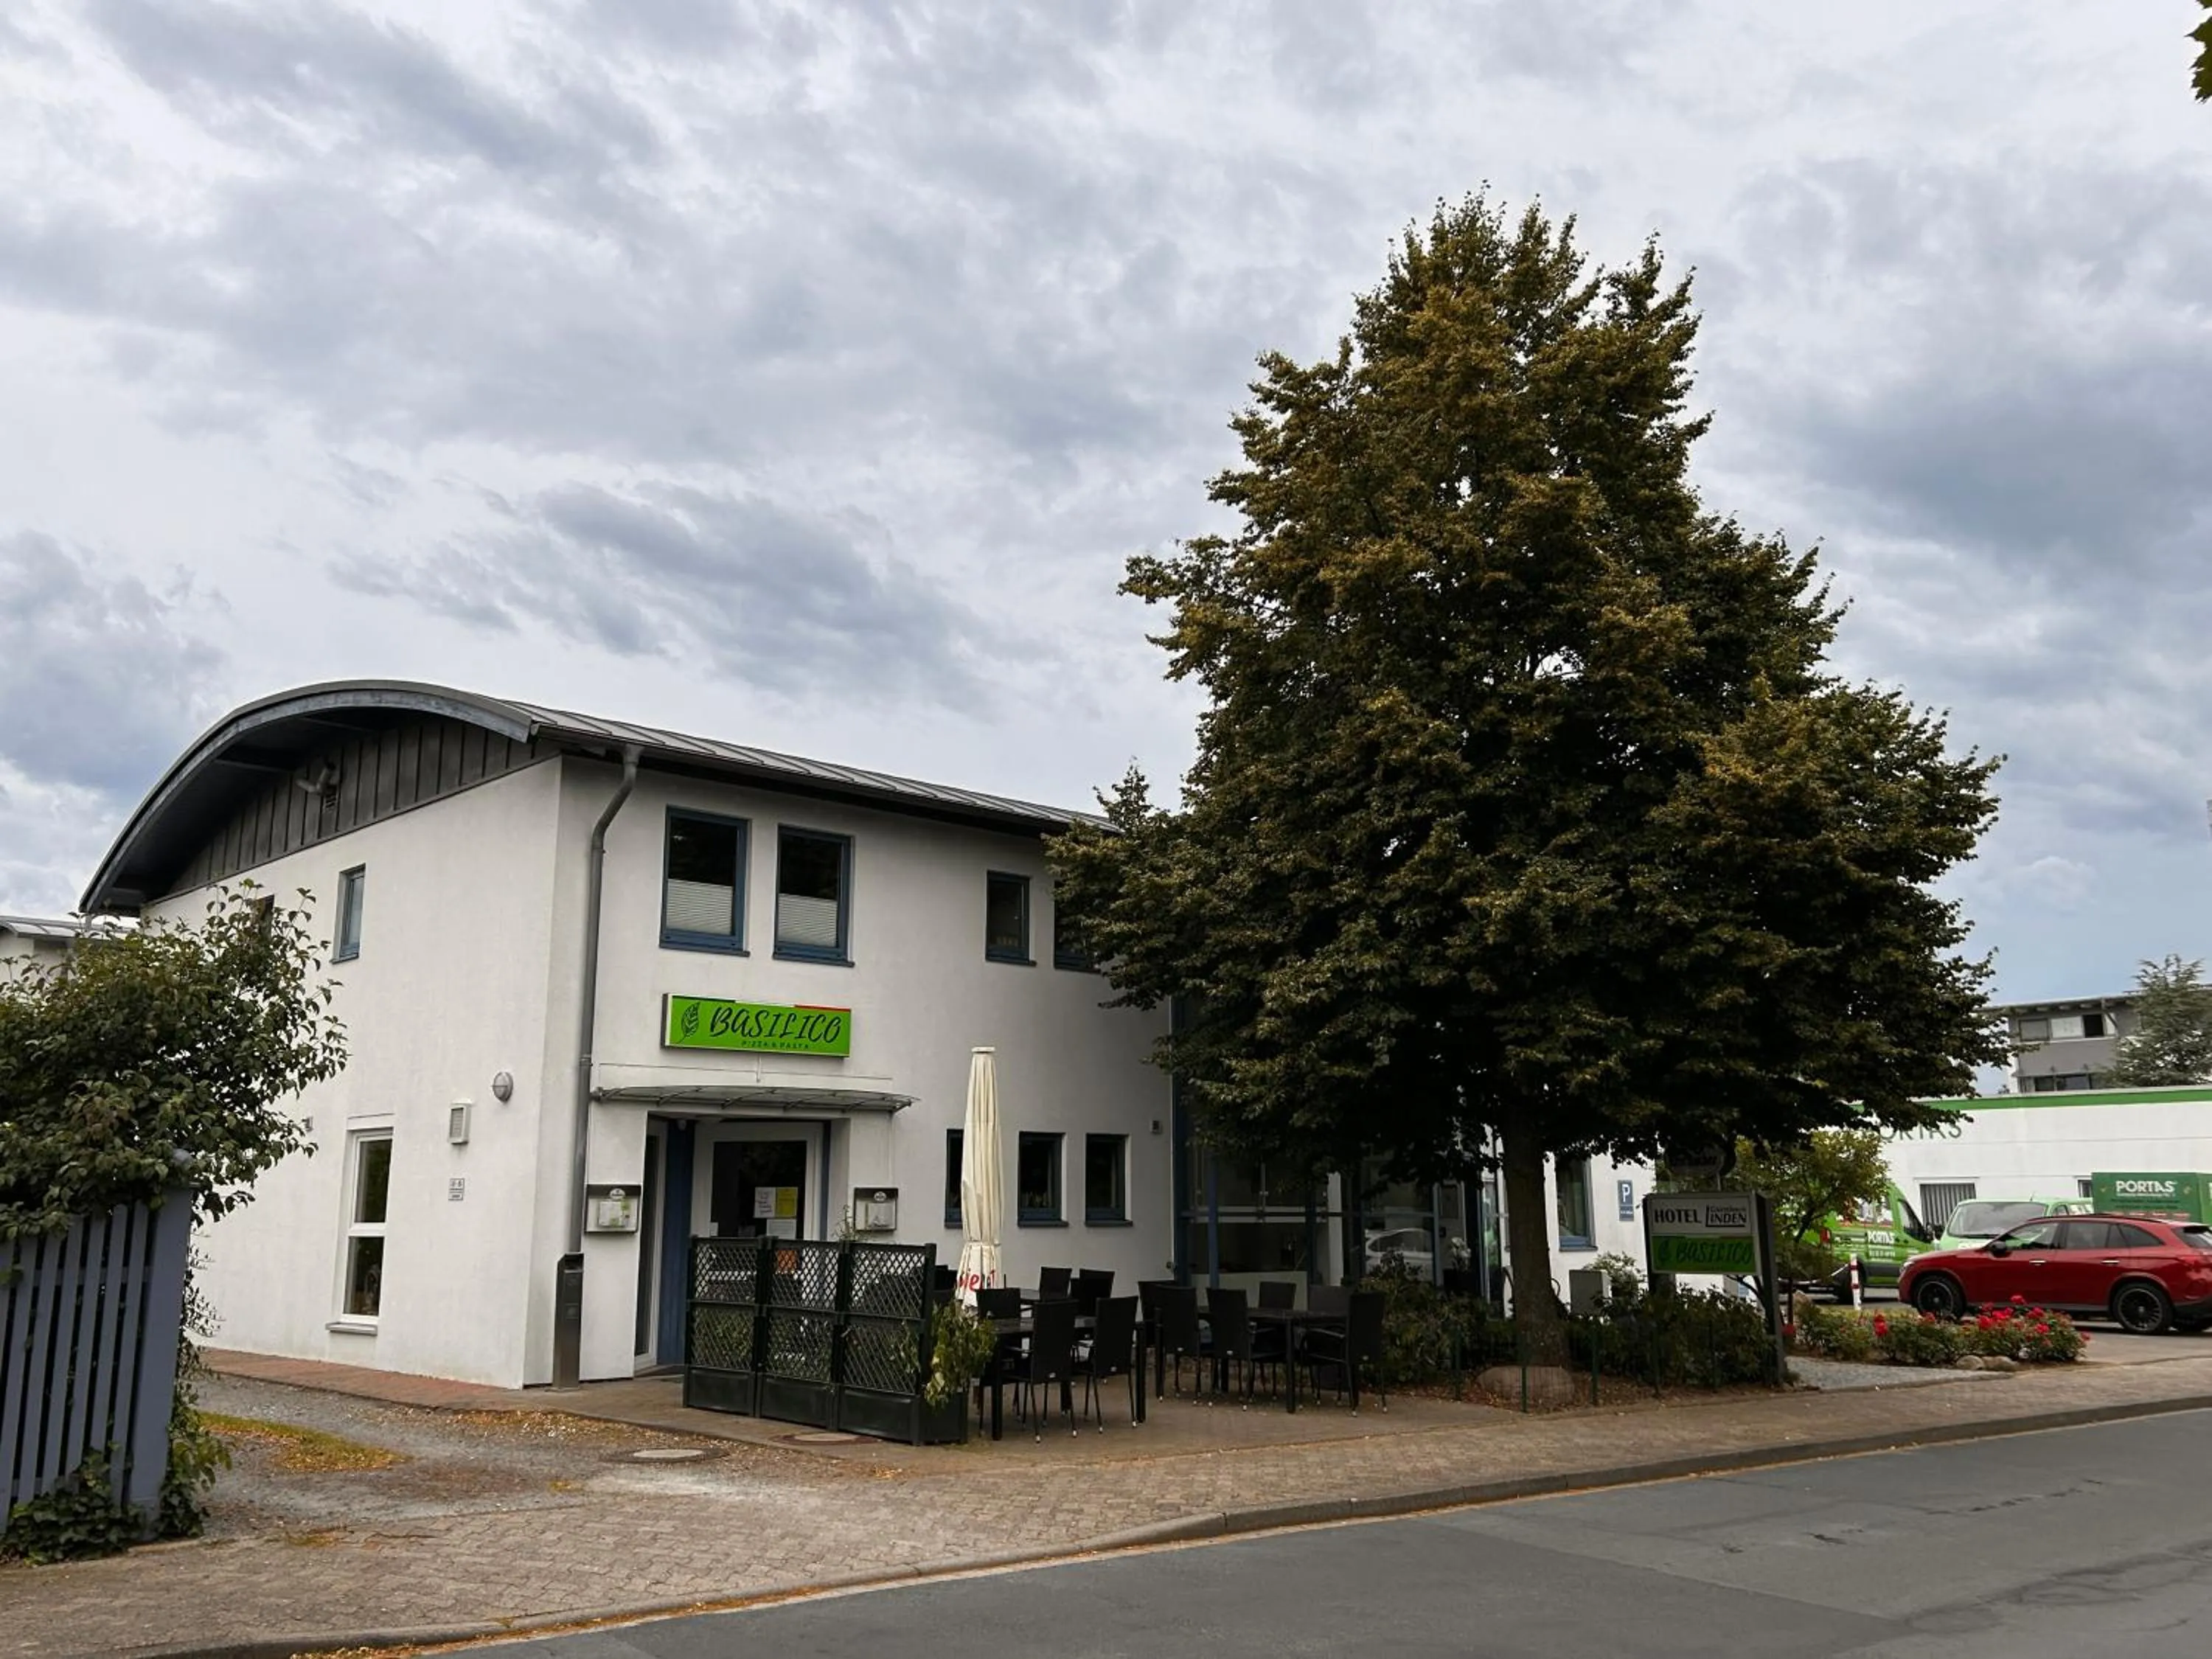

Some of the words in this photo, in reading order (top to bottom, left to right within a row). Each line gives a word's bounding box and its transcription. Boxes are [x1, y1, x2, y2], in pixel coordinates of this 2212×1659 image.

[709, 1006, 842, 1043] BASILICO
[1622, 1183, 1630, 1203] P
[2115, 1180, 2175, 1192] PORTAS
[1655, 1208, 1701, 1223] HOTEL
[1868, 1231, 1895, 1245] PORTAS
[1676, 1241, 1753, 1264] BASILICO
